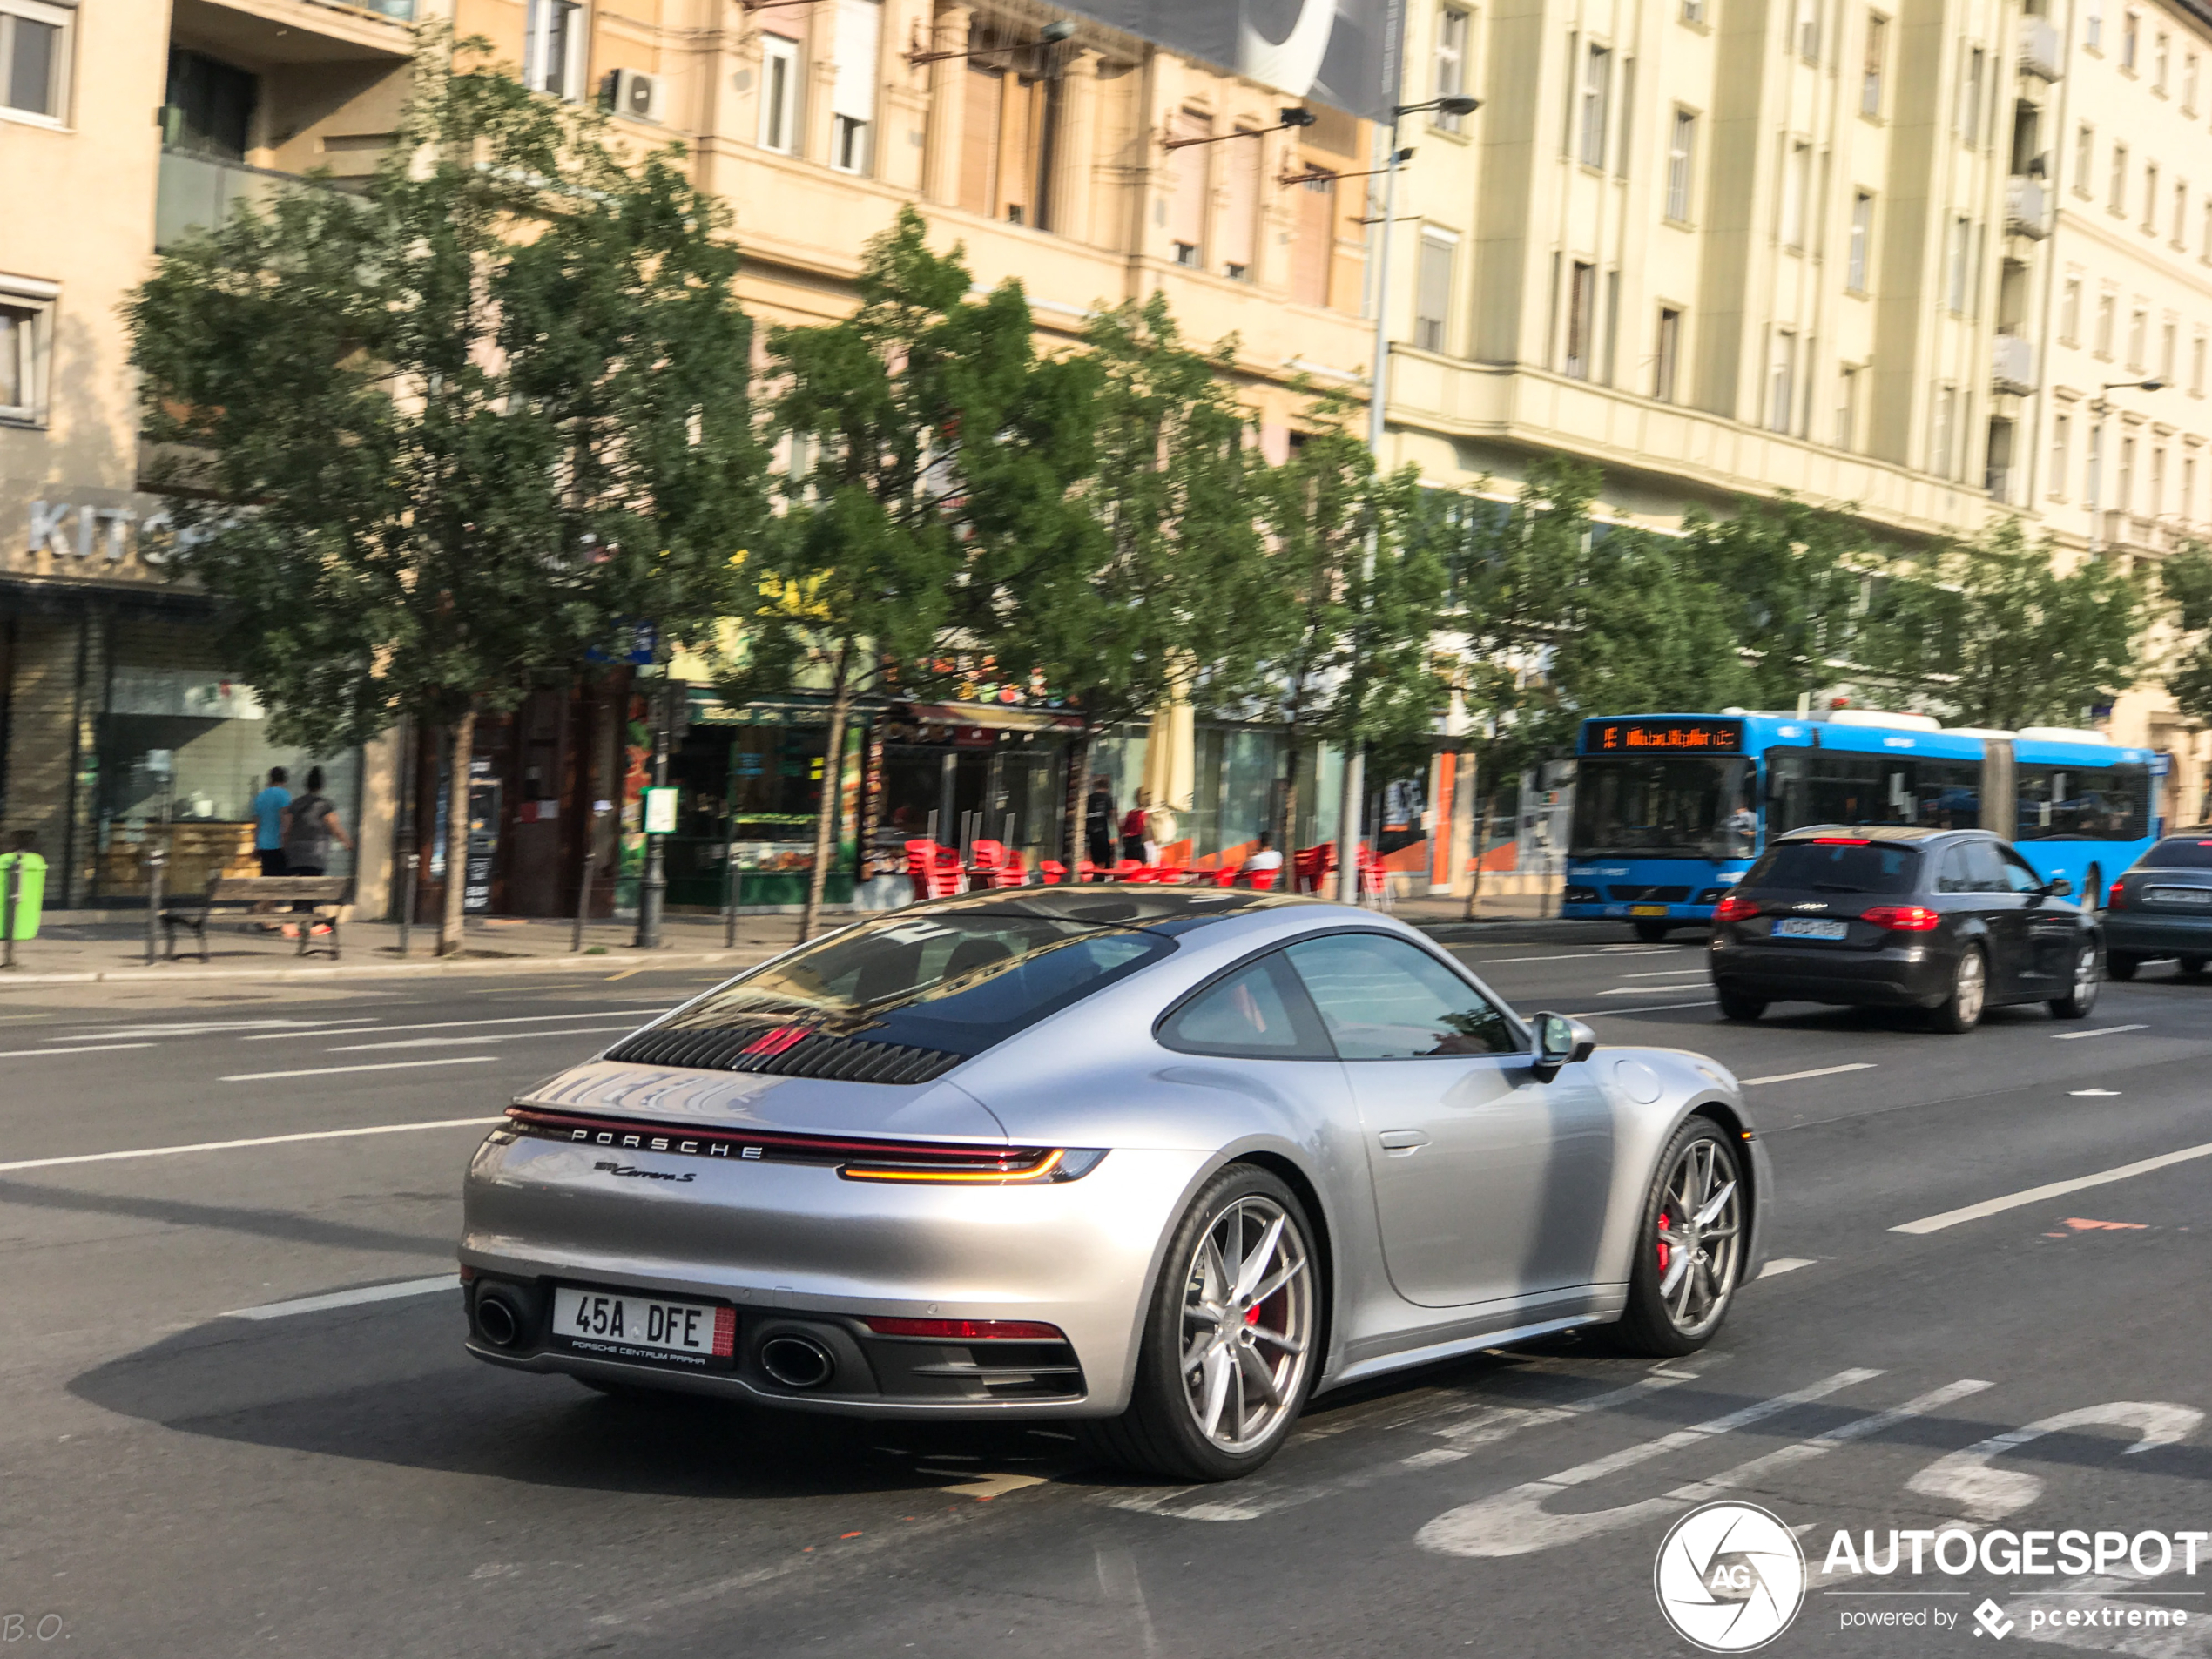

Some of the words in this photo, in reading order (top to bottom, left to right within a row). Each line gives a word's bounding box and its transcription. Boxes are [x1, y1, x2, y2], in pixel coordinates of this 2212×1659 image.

[571, 1129, 764, 1159] PORSCHE
[611, 1165, 677, 1181] Carrera
[676, 1172, 697, 1183] S
[575, 1295, 624, 1339] 45A
[646, 1304, 702, 1348] DFE
[571, 1340, 617, 1354] PORSCHE
[618, 1345, 668, 1361] CENTRUM
[669, 1353, 706, 1366] PRAHA
